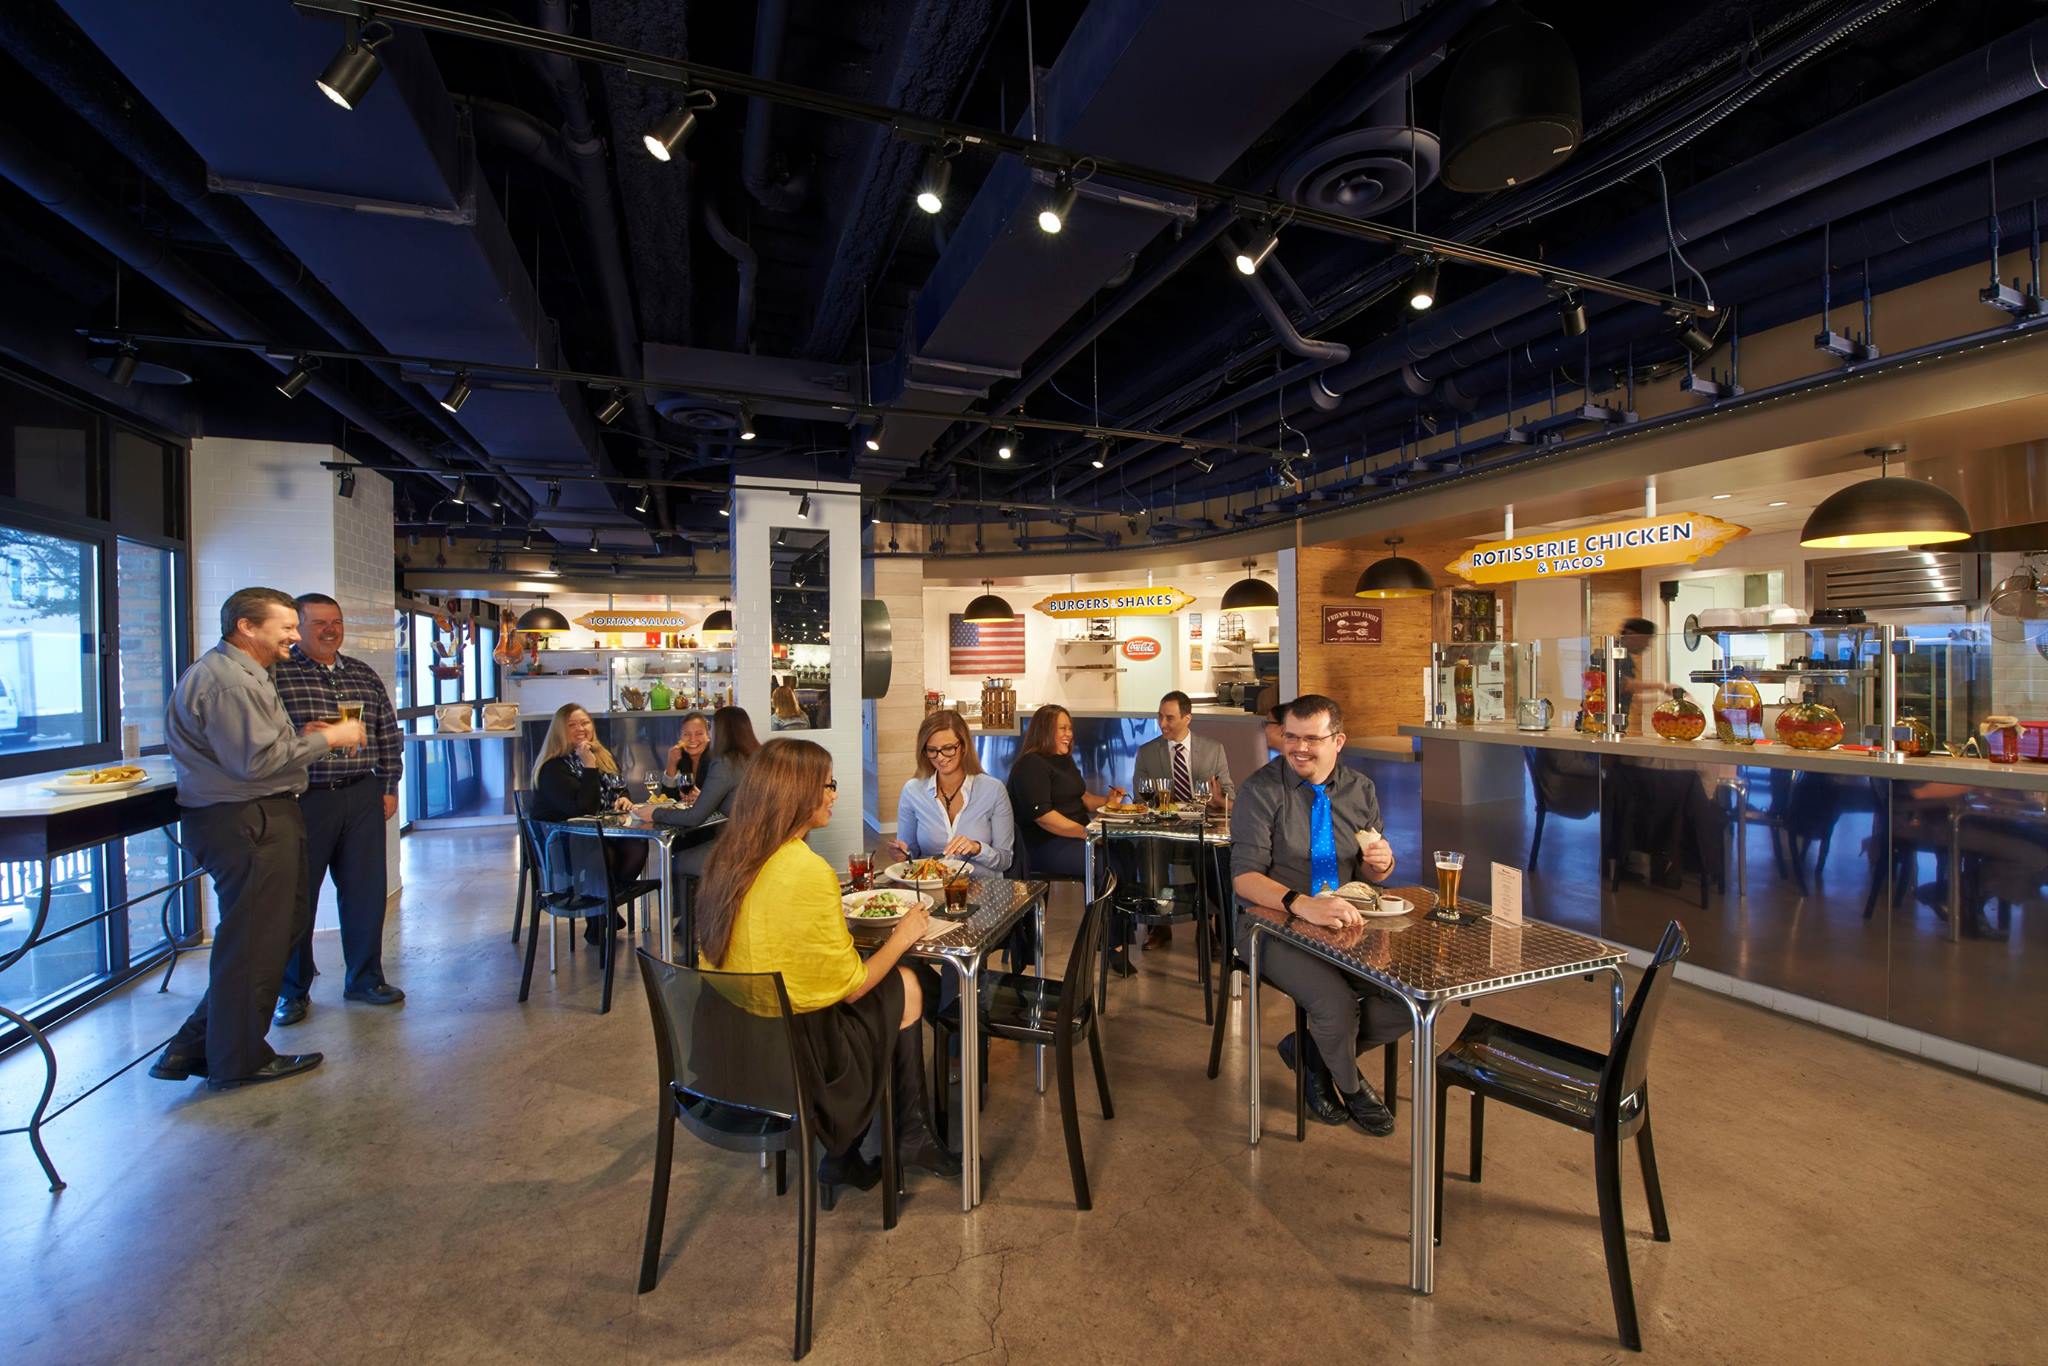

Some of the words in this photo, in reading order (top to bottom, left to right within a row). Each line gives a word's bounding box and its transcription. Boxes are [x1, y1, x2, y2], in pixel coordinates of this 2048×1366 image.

[1473, 539, 1577, 567] ROTISSERIE
[1585, 522, 1692, 551] CHICKEN
[1537, 561, 1548, 574] &
[1553, 555, 1604, 572] TACOS
[1050, 598, 1109, 611] BURGERS
[1117, 594, 1172, 607] SHAKES
[590, 617, 634, 626] TORTAS
[641, 617, 685, 626] SALADS
